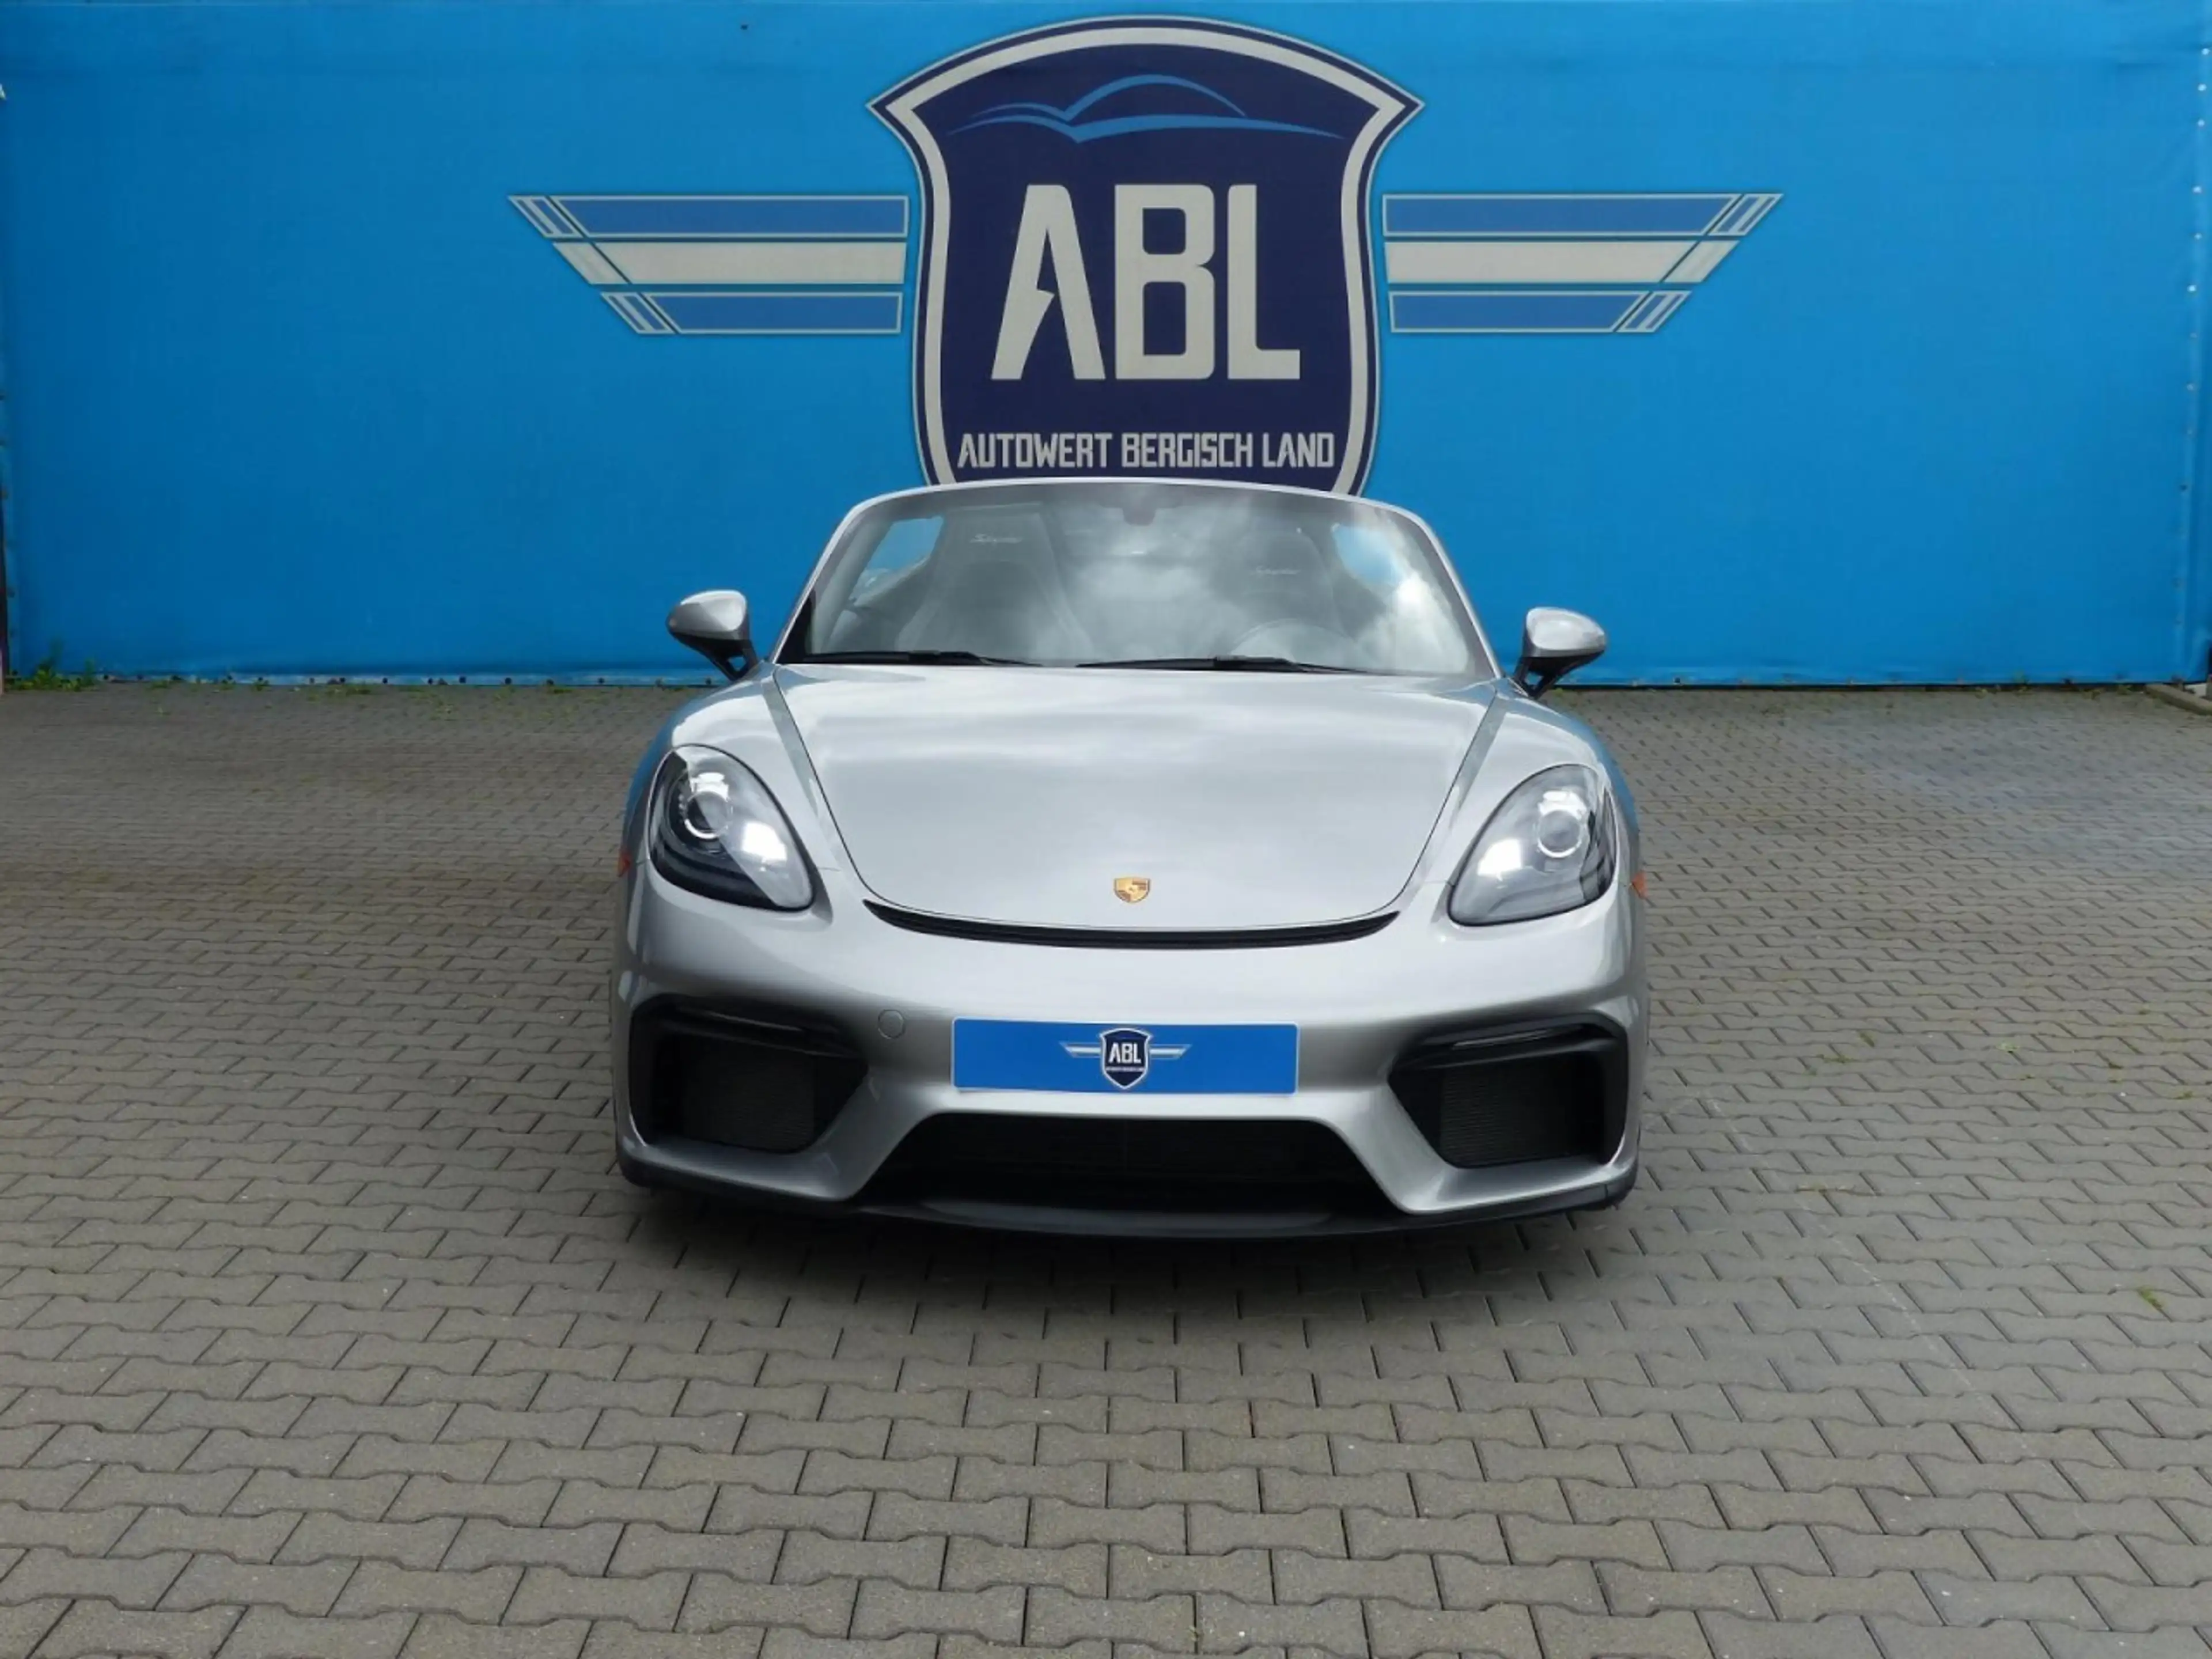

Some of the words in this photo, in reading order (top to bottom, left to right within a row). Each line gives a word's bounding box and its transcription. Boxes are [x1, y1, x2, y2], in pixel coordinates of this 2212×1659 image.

[990, 184, 1301, 380] ABL
[957, 432, 1112, 468] AUTOWERT
[1121, 432, 1253, 468] BERGISCH
[1262, 432, 1335, 468] LAND
[1108, 1042, 1141, 1063] ABL
